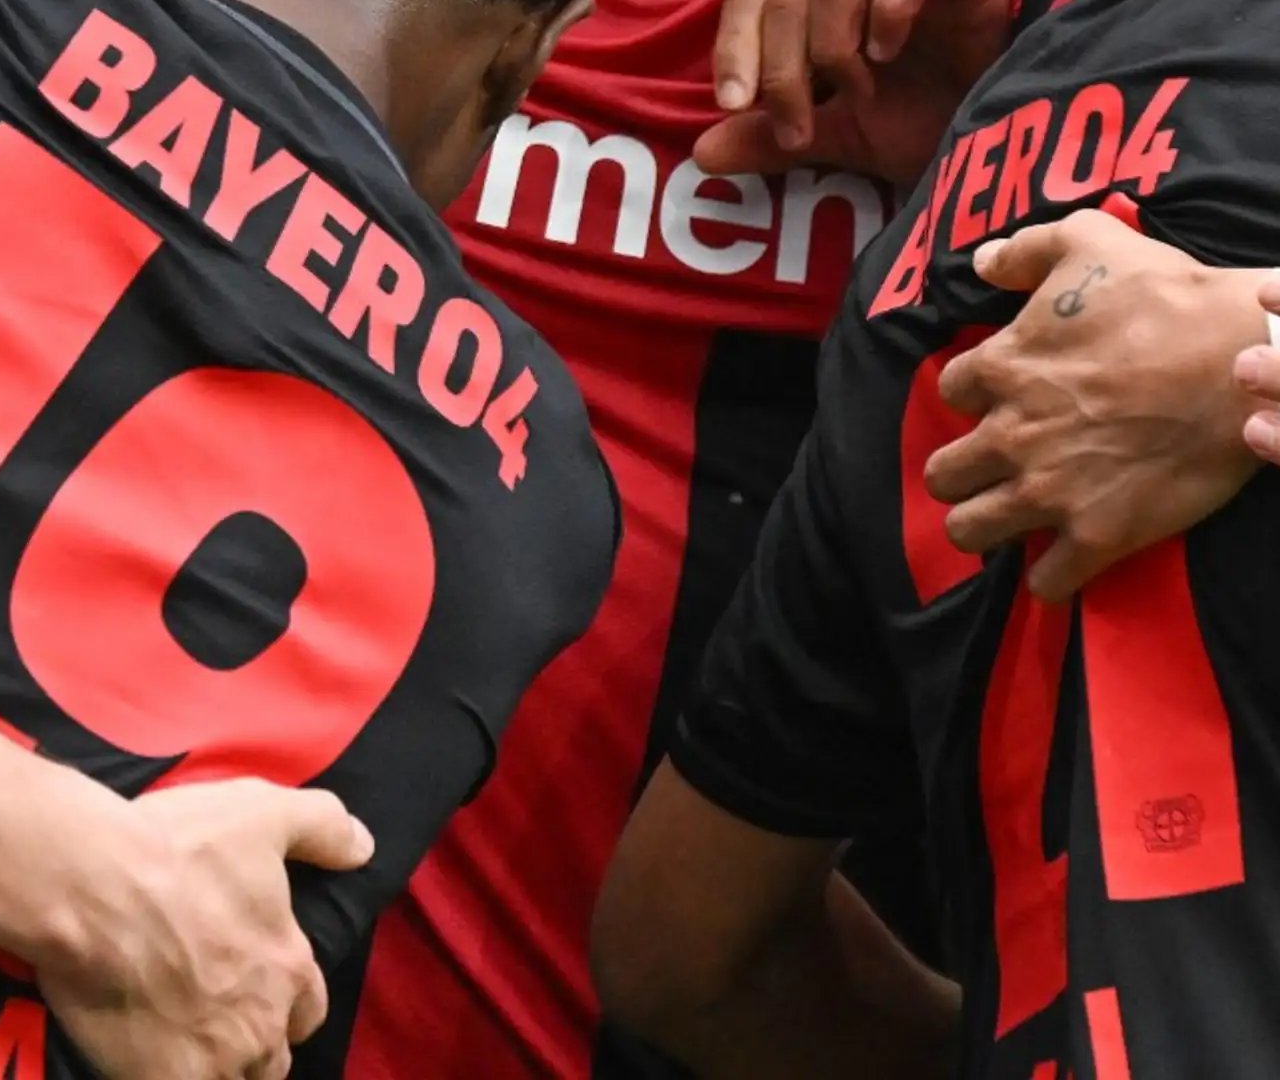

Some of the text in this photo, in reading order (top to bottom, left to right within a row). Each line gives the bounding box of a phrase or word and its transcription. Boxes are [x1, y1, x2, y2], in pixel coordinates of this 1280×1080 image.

[38, 7, 541, 493] BAYER 04
[866, 76, 1191, 321] BYER 04
